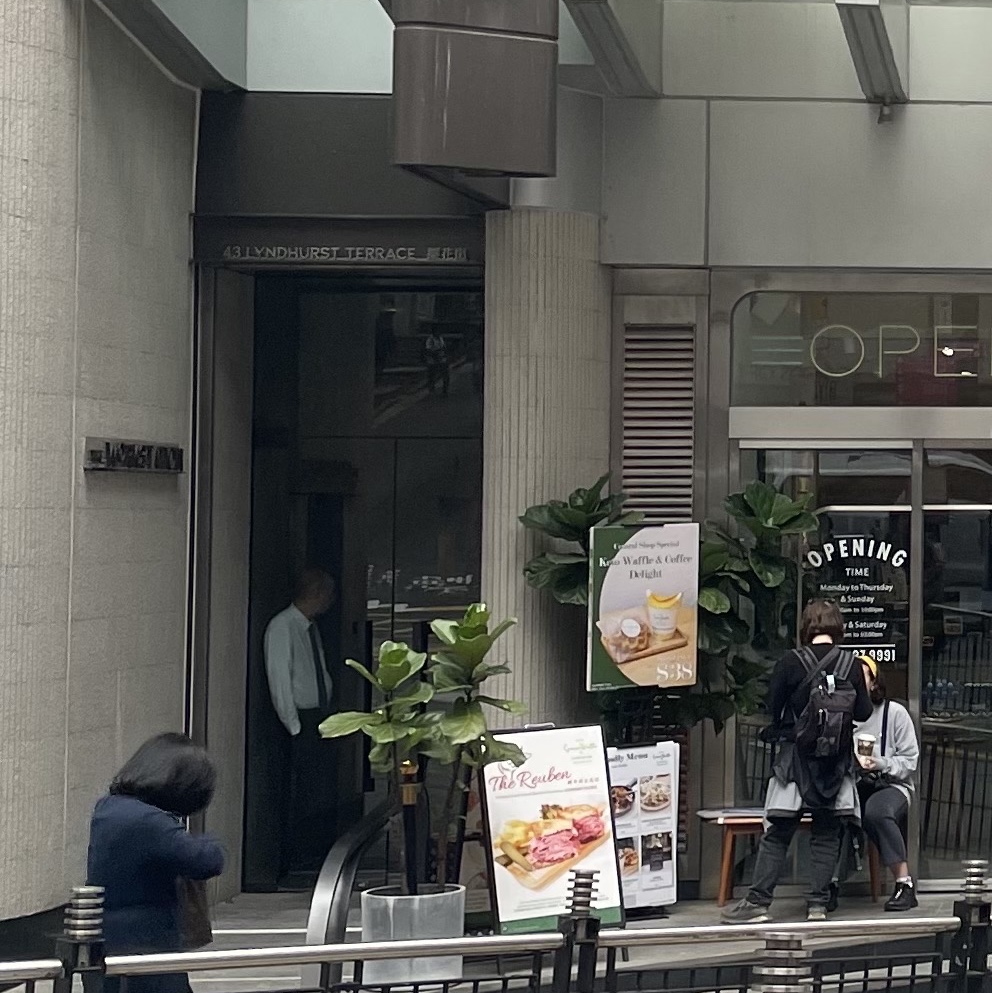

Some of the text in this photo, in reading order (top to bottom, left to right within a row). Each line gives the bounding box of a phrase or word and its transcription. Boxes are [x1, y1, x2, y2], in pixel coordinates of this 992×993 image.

[223, 247, 416, 259] 43 LYNDHURST TERRACE
[807, 539, 908, 567] OPENING
[623, 555, 654, 566] Waffle
[655, 556, 663, 565] &
[664, 554, 693, 564] Coffee
[629, 568, 663, 580] Delight
[845, 567, 870, 577] TIME
[820, 584, 850, 592] Monday
[860, 584, 894, 592] Thursday
[847, 595, 875, 604] Sunday
[855, 621, 887, 629] Saturday
[488, 766, 572, 792] The Reuben
